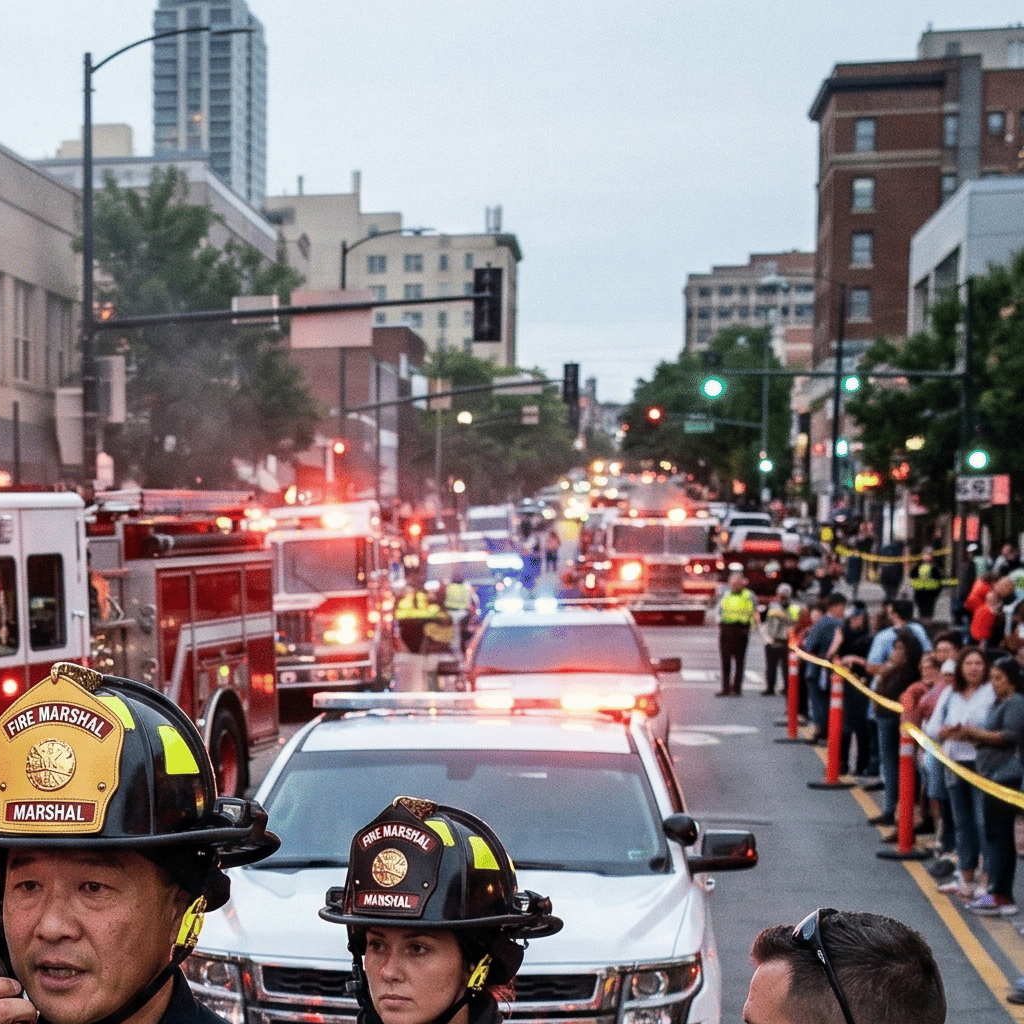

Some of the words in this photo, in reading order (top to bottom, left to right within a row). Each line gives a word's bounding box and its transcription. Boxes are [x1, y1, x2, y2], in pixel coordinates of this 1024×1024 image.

[7, 713, 36, 737] FIRE
[38, 702, 104, 738] MARSHAL
[13, 804, 85, 822] MARSHAL
